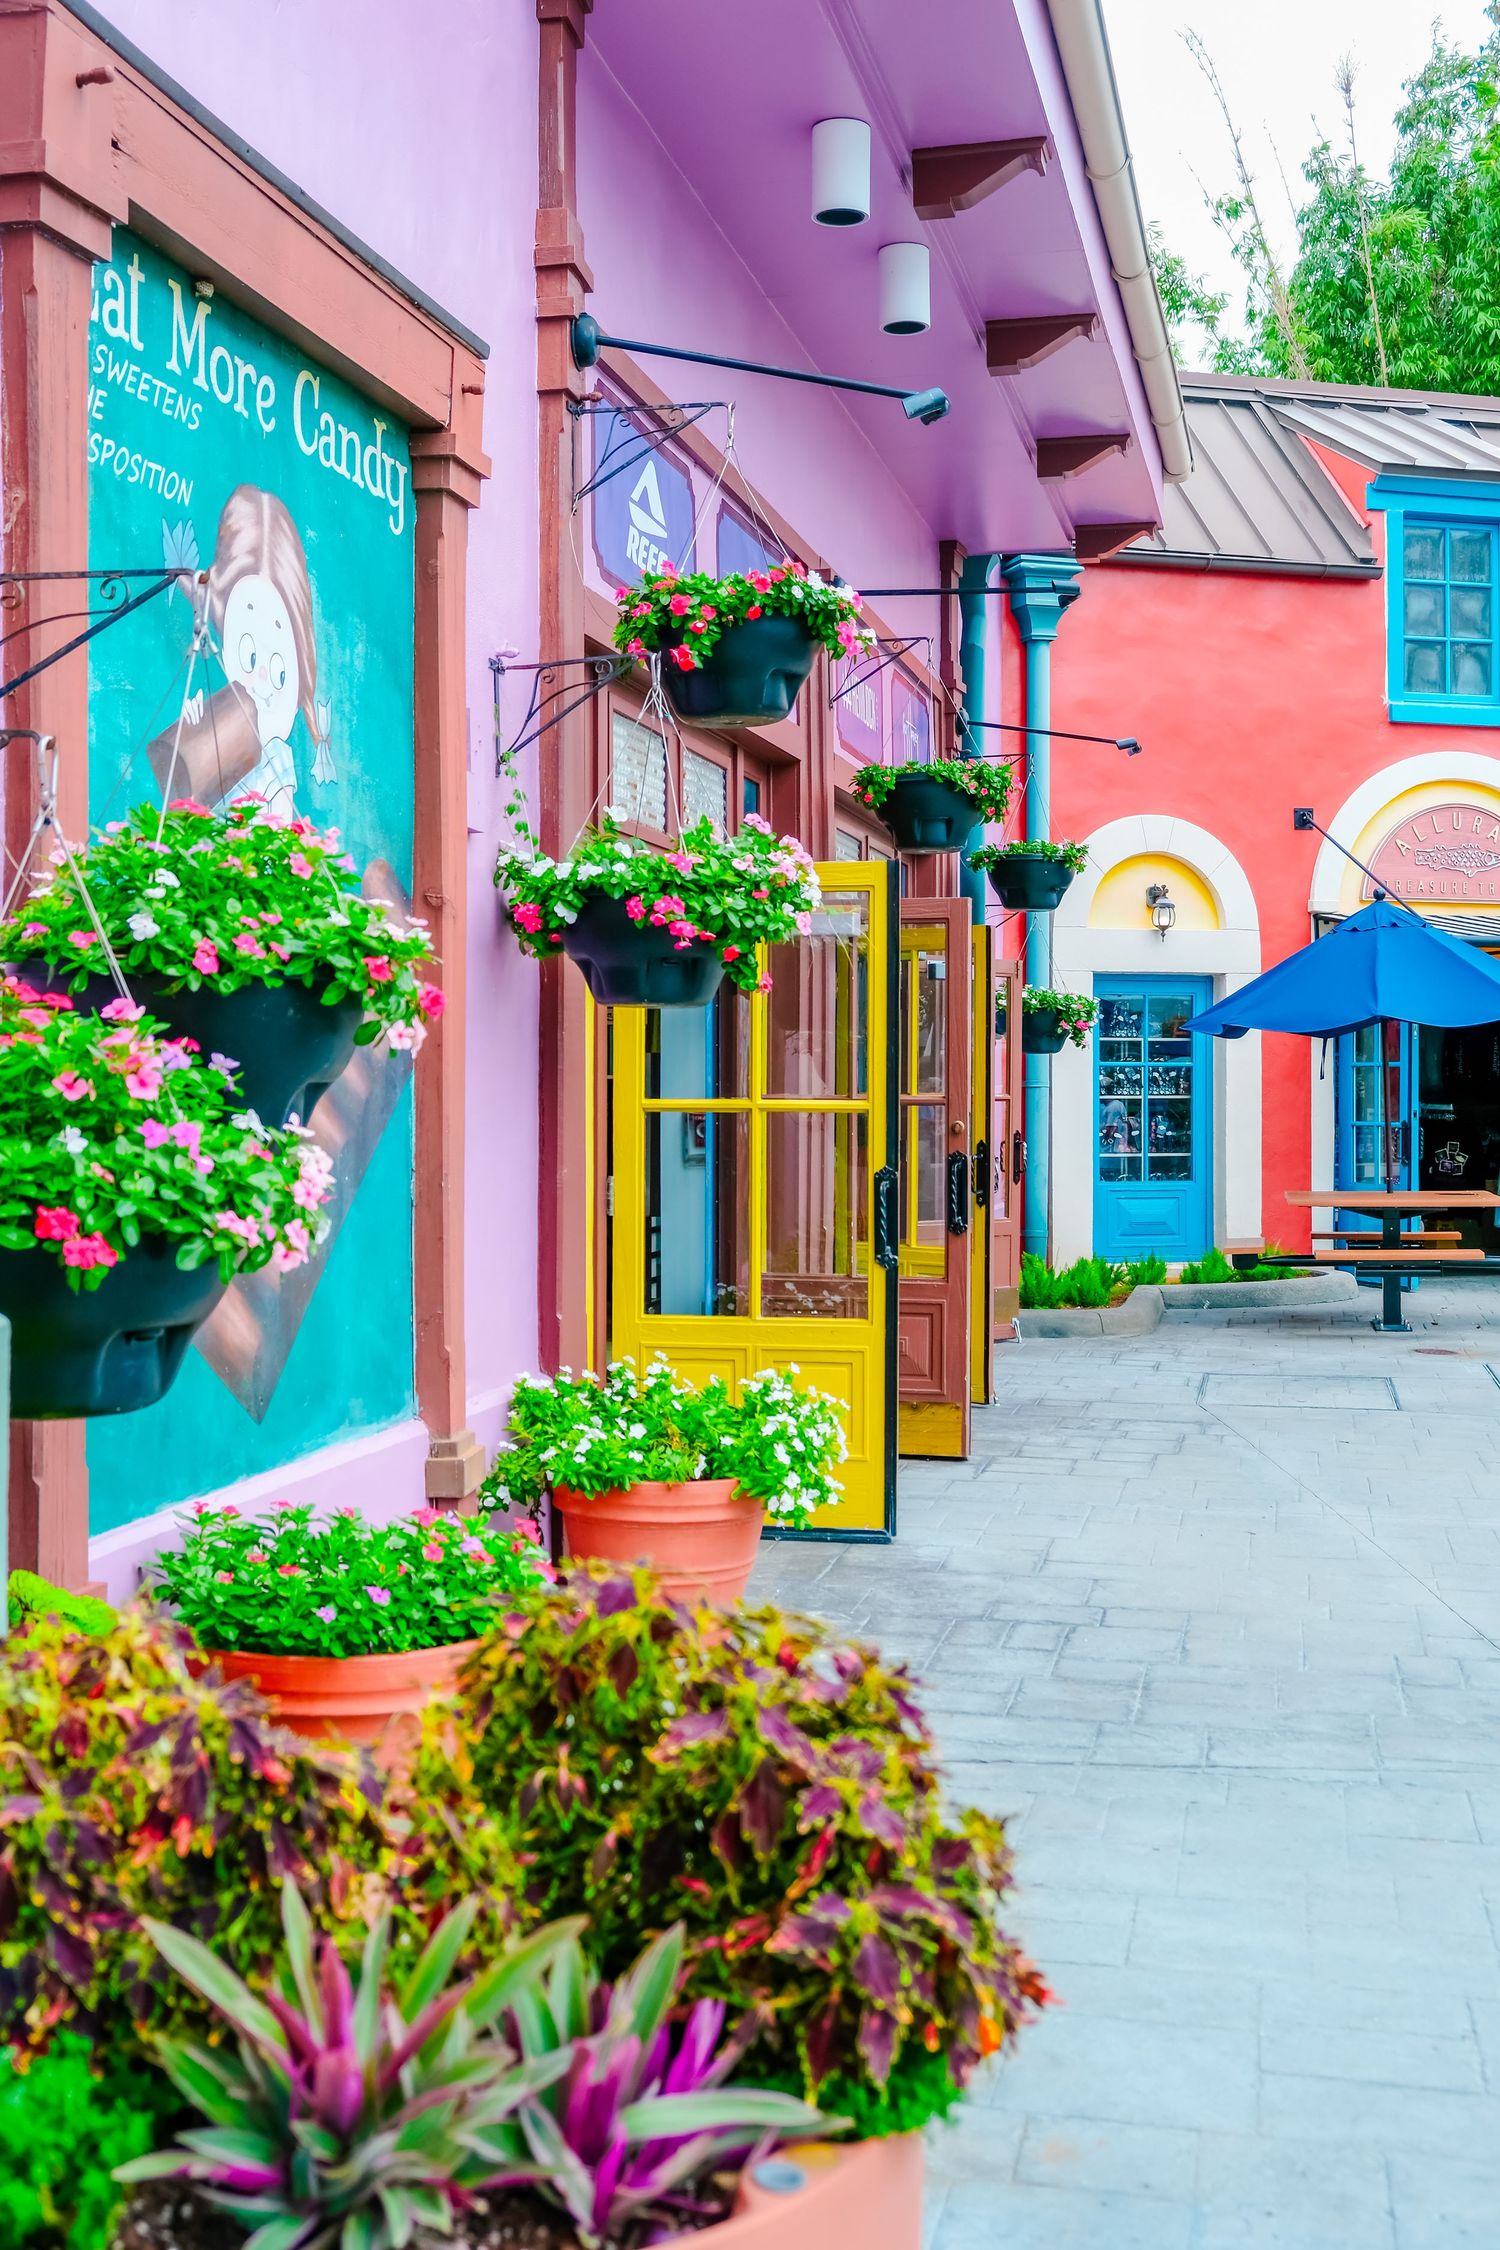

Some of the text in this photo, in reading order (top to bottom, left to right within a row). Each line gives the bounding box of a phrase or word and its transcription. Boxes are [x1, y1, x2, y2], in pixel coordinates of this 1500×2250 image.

[91, 253, 407, 535] at More Candy
[93, 344, 202, 430] SWEETENS
[88, 431, 194, 507] SPOSITION
[1395, 811, 1500, 857] ALLURA
[1385, 879, 1469, 895] TREASURE
